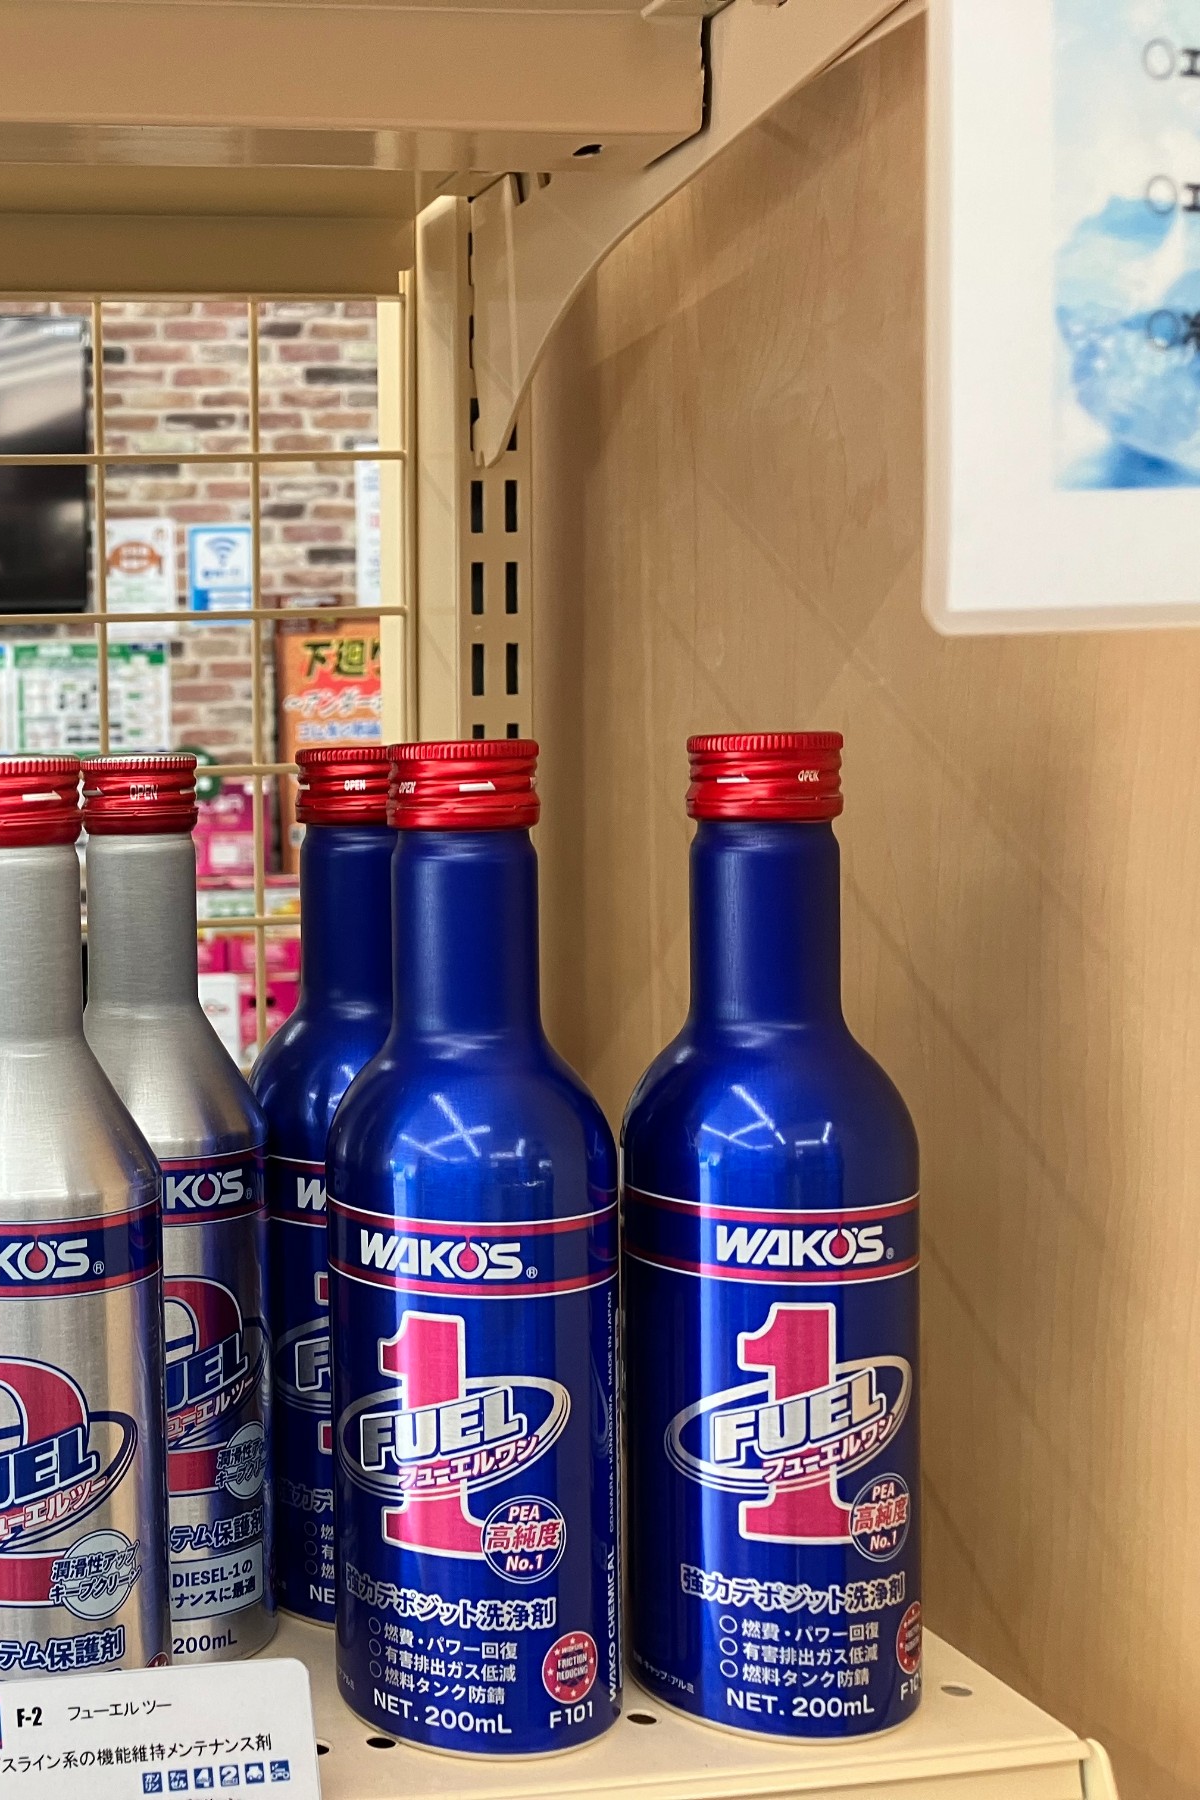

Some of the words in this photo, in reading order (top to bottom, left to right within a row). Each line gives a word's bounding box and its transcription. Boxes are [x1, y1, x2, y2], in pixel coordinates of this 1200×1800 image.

[129, 784, 158, 800] OPEN
[344, 780, 366, 790] OPEN
[360, 1229, 523, 1280] WAKO'S
[716, 1225, 884, 1267] WAKO'S
[360, 1387, 527, 1471] FUEL
[710, 1367, 887, 1467] FUEL
[398, 1435, 539, 1490] フューエルワン
[762, 1414, 895, 1484] フューエルワン
[872, 1483, 895, 1500] PEA
[508, 1504, 540, 1521] PEA
[852, 1493, 909, 1536] 高純度
[486, 1520, 562, 1551] 高純度
[870, 1533, 898, 1551] No.1
[51, 1540, 141, 1582] 潤滑性アップ
[505, 1553, 544, 1572] No.1
[49, 1566, 142, 1603] キープクリーン
[345, 1562, 557, 1629] 強力デポジット洗浄剤
[607, 1545, 616, 1639] CHEMICAL
[680, 1563, 906, 1616] 強力デポジット洗浄剤
[173, 1629, 238, 1655] 200mL
[384, 1622, 518, 1661] 燃費・パワー回復
[741, 1619, 880, 1643] 燃費・パワー回復
[384, 1645, 518, 1683] 有害排出ガス低減
[609, 1642, 618, 1702] WAKO
[741, 1643, 879, 1667] 有害排出ガス低減
[384, 1666, 505, 1705] 燃料タンク防錆
[741, 1665, 870, 1688] 燃料タンク防錆
[16, 1706, 43, 1727] F-2
[67, 1700, 174, 1722] フューエルツー
[373, 1688, 420, 1722] NET.
[425, 1704, 513, 1735] 200mL
[550, 1701, 594, 1730] F101
[726, 1688, 785, 1717] NET.
[792, 1695, 875, 1719] 200mL
